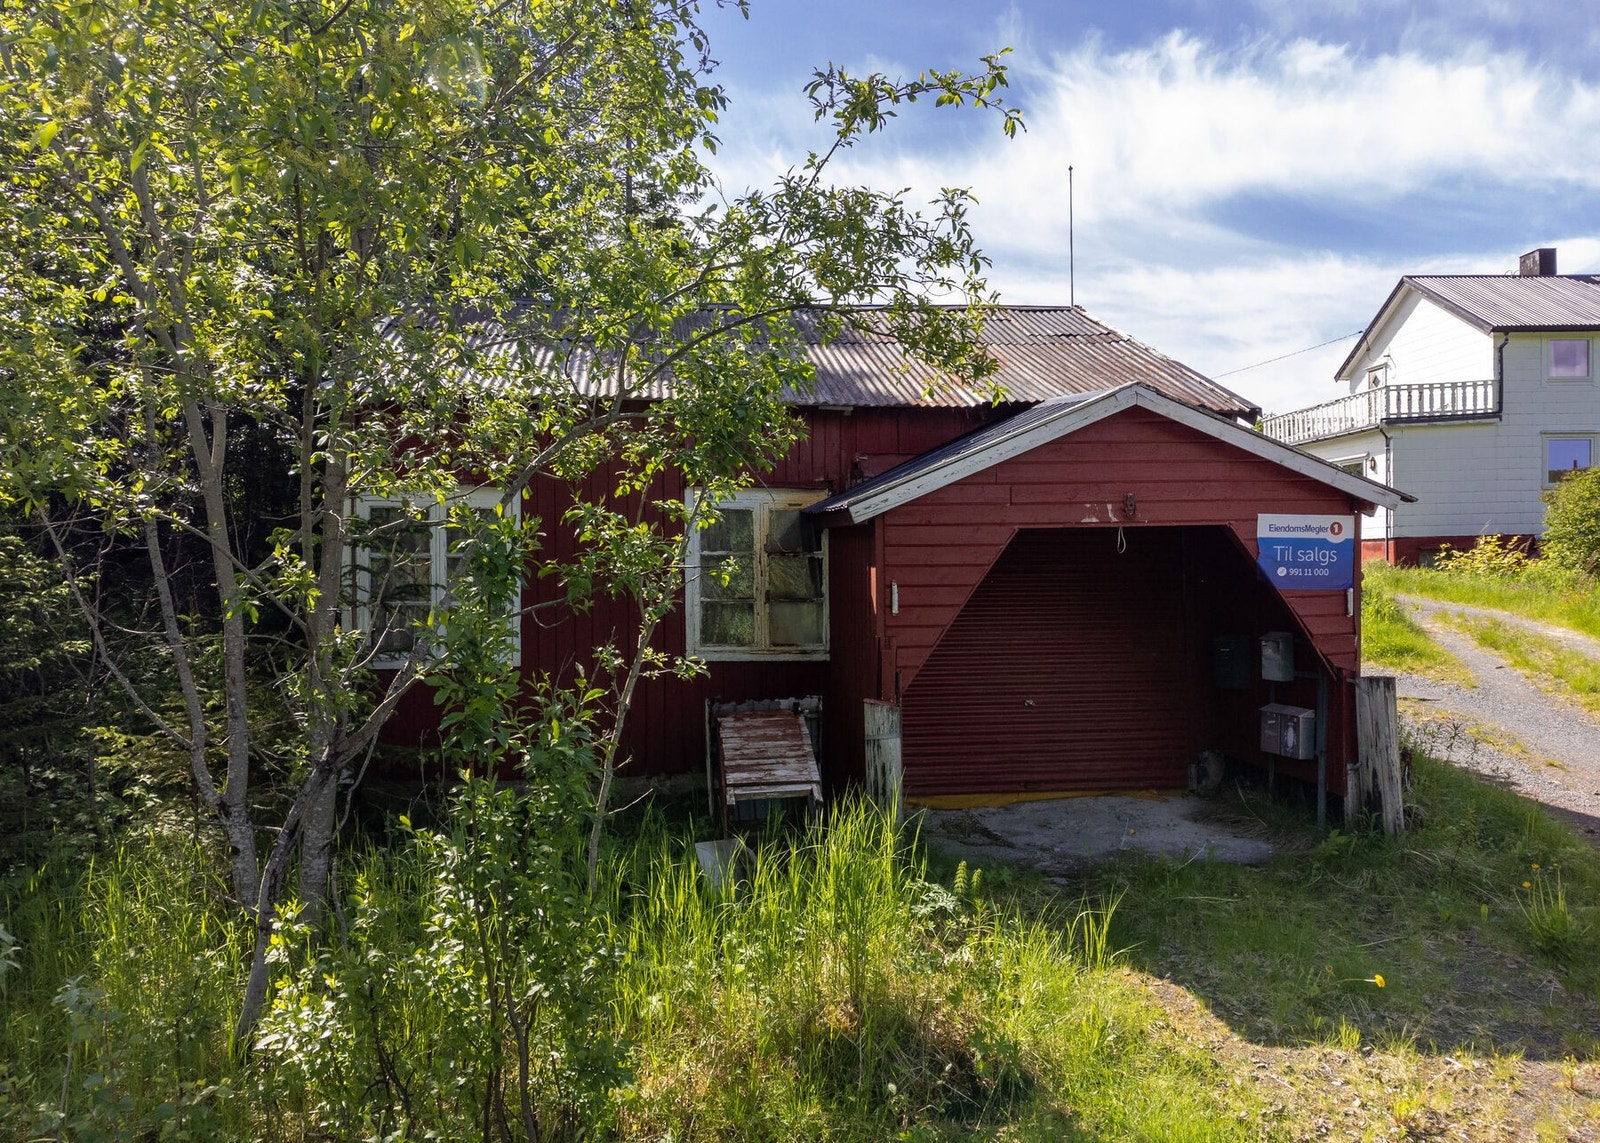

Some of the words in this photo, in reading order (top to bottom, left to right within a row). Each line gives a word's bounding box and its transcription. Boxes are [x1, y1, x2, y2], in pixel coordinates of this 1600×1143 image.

[1269, 524, 1328, 535] EiendomsMegler
[1273, 545, 1292, 561] Til
[1297, 546, 1337, 566] salgs
[1289, 568, 1302, 576] 991
[1304, 568, 1312, 576] 11
[1313, 568, 1329, 576] 000
